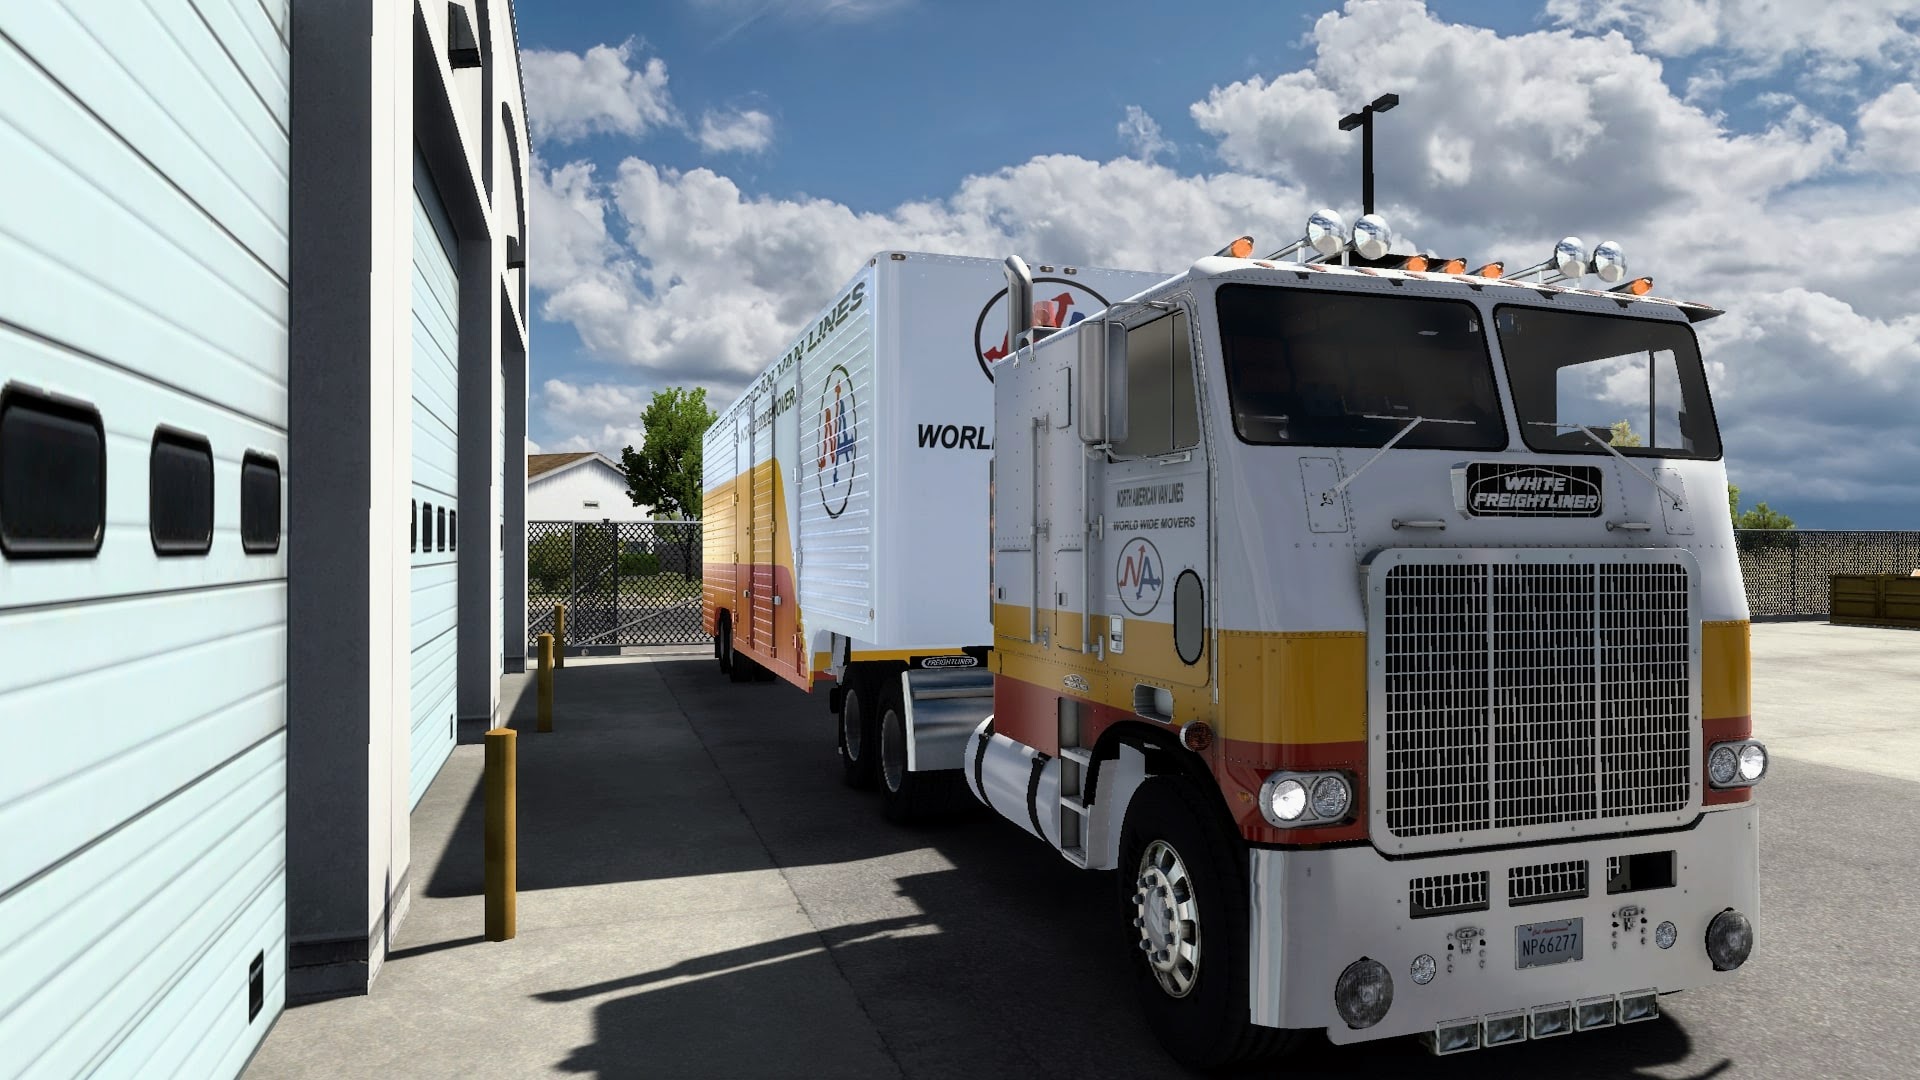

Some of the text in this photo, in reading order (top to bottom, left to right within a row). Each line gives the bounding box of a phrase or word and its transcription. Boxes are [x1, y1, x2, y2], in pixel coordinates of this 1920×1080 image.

[806, 281, 866, 353] LINES
[917, 424, 995, 451] WORL
[1504, 476, 1567, 492] WHITE
[1116, 481, 1184, 509] NORTH AMERICAN VAN LINES
[1473, 493, 1599, 509] FREIGHTLINER
[1113, 516, 1196, 531] WORLD WIDE MOVERS
[927, 658, 973, 666] FREIGHTLINER
[1522, 933, 1578, 957] NP66277
